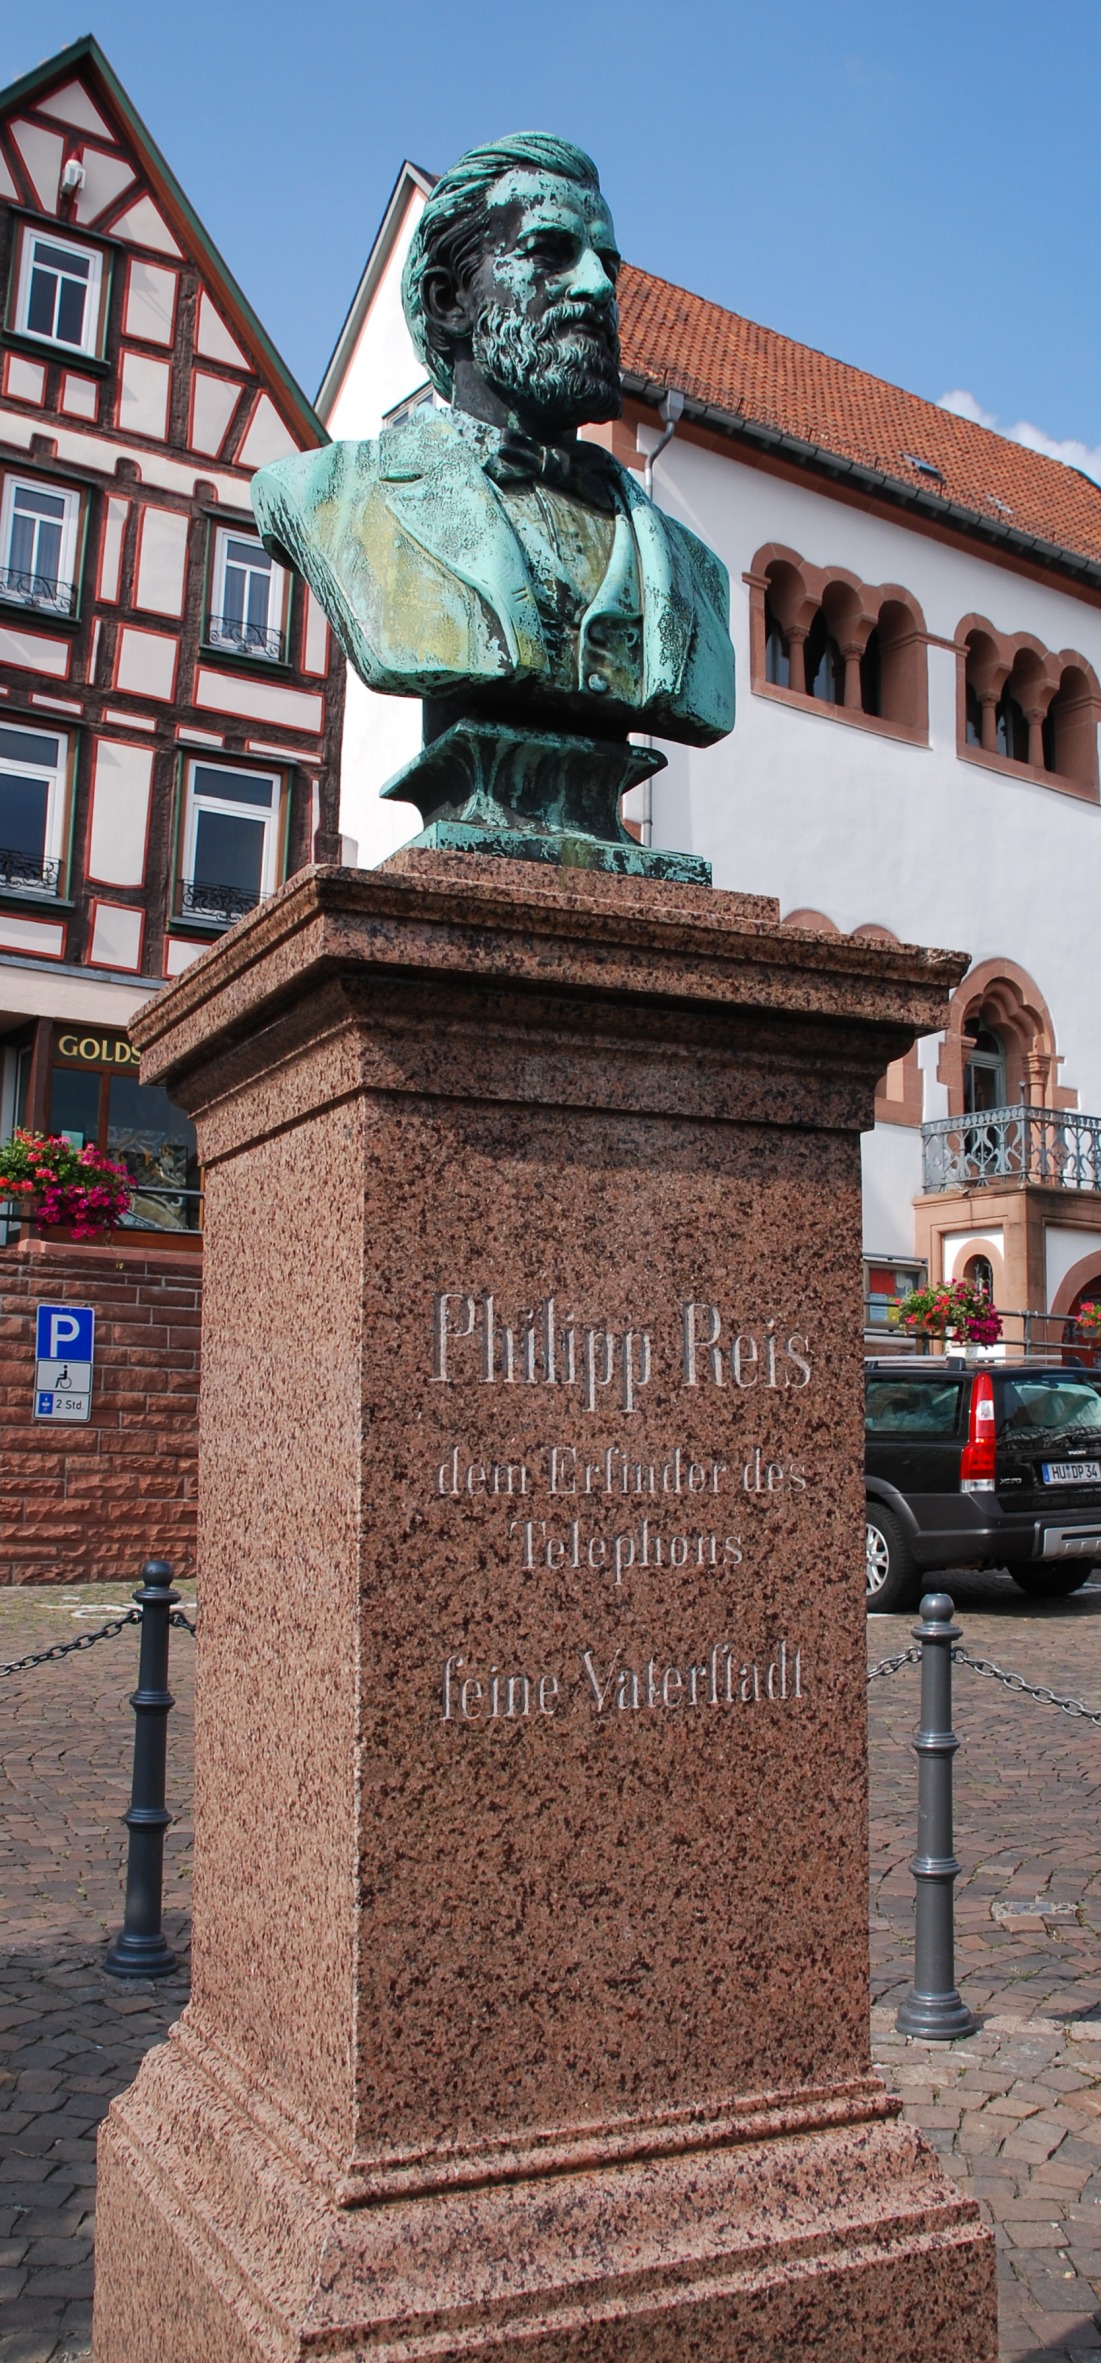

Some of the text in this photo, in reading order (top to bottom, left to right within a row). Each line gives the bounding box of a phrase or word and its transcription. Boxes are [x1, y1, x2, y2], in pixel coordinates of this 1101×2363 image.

[59, 1035, 141, 1065] GOLDS
[50, 1313, 80, 1357] P
[429, 1292, 812, 1413] Philipp Reis
[56, 1399, 62, 1409] 2
[438, 1446, 808, 1495] dem Erfinder des
[1052, 1464, 1098, 1479] HU DP 34
[509, 1519, 744, 1586] Telephons
